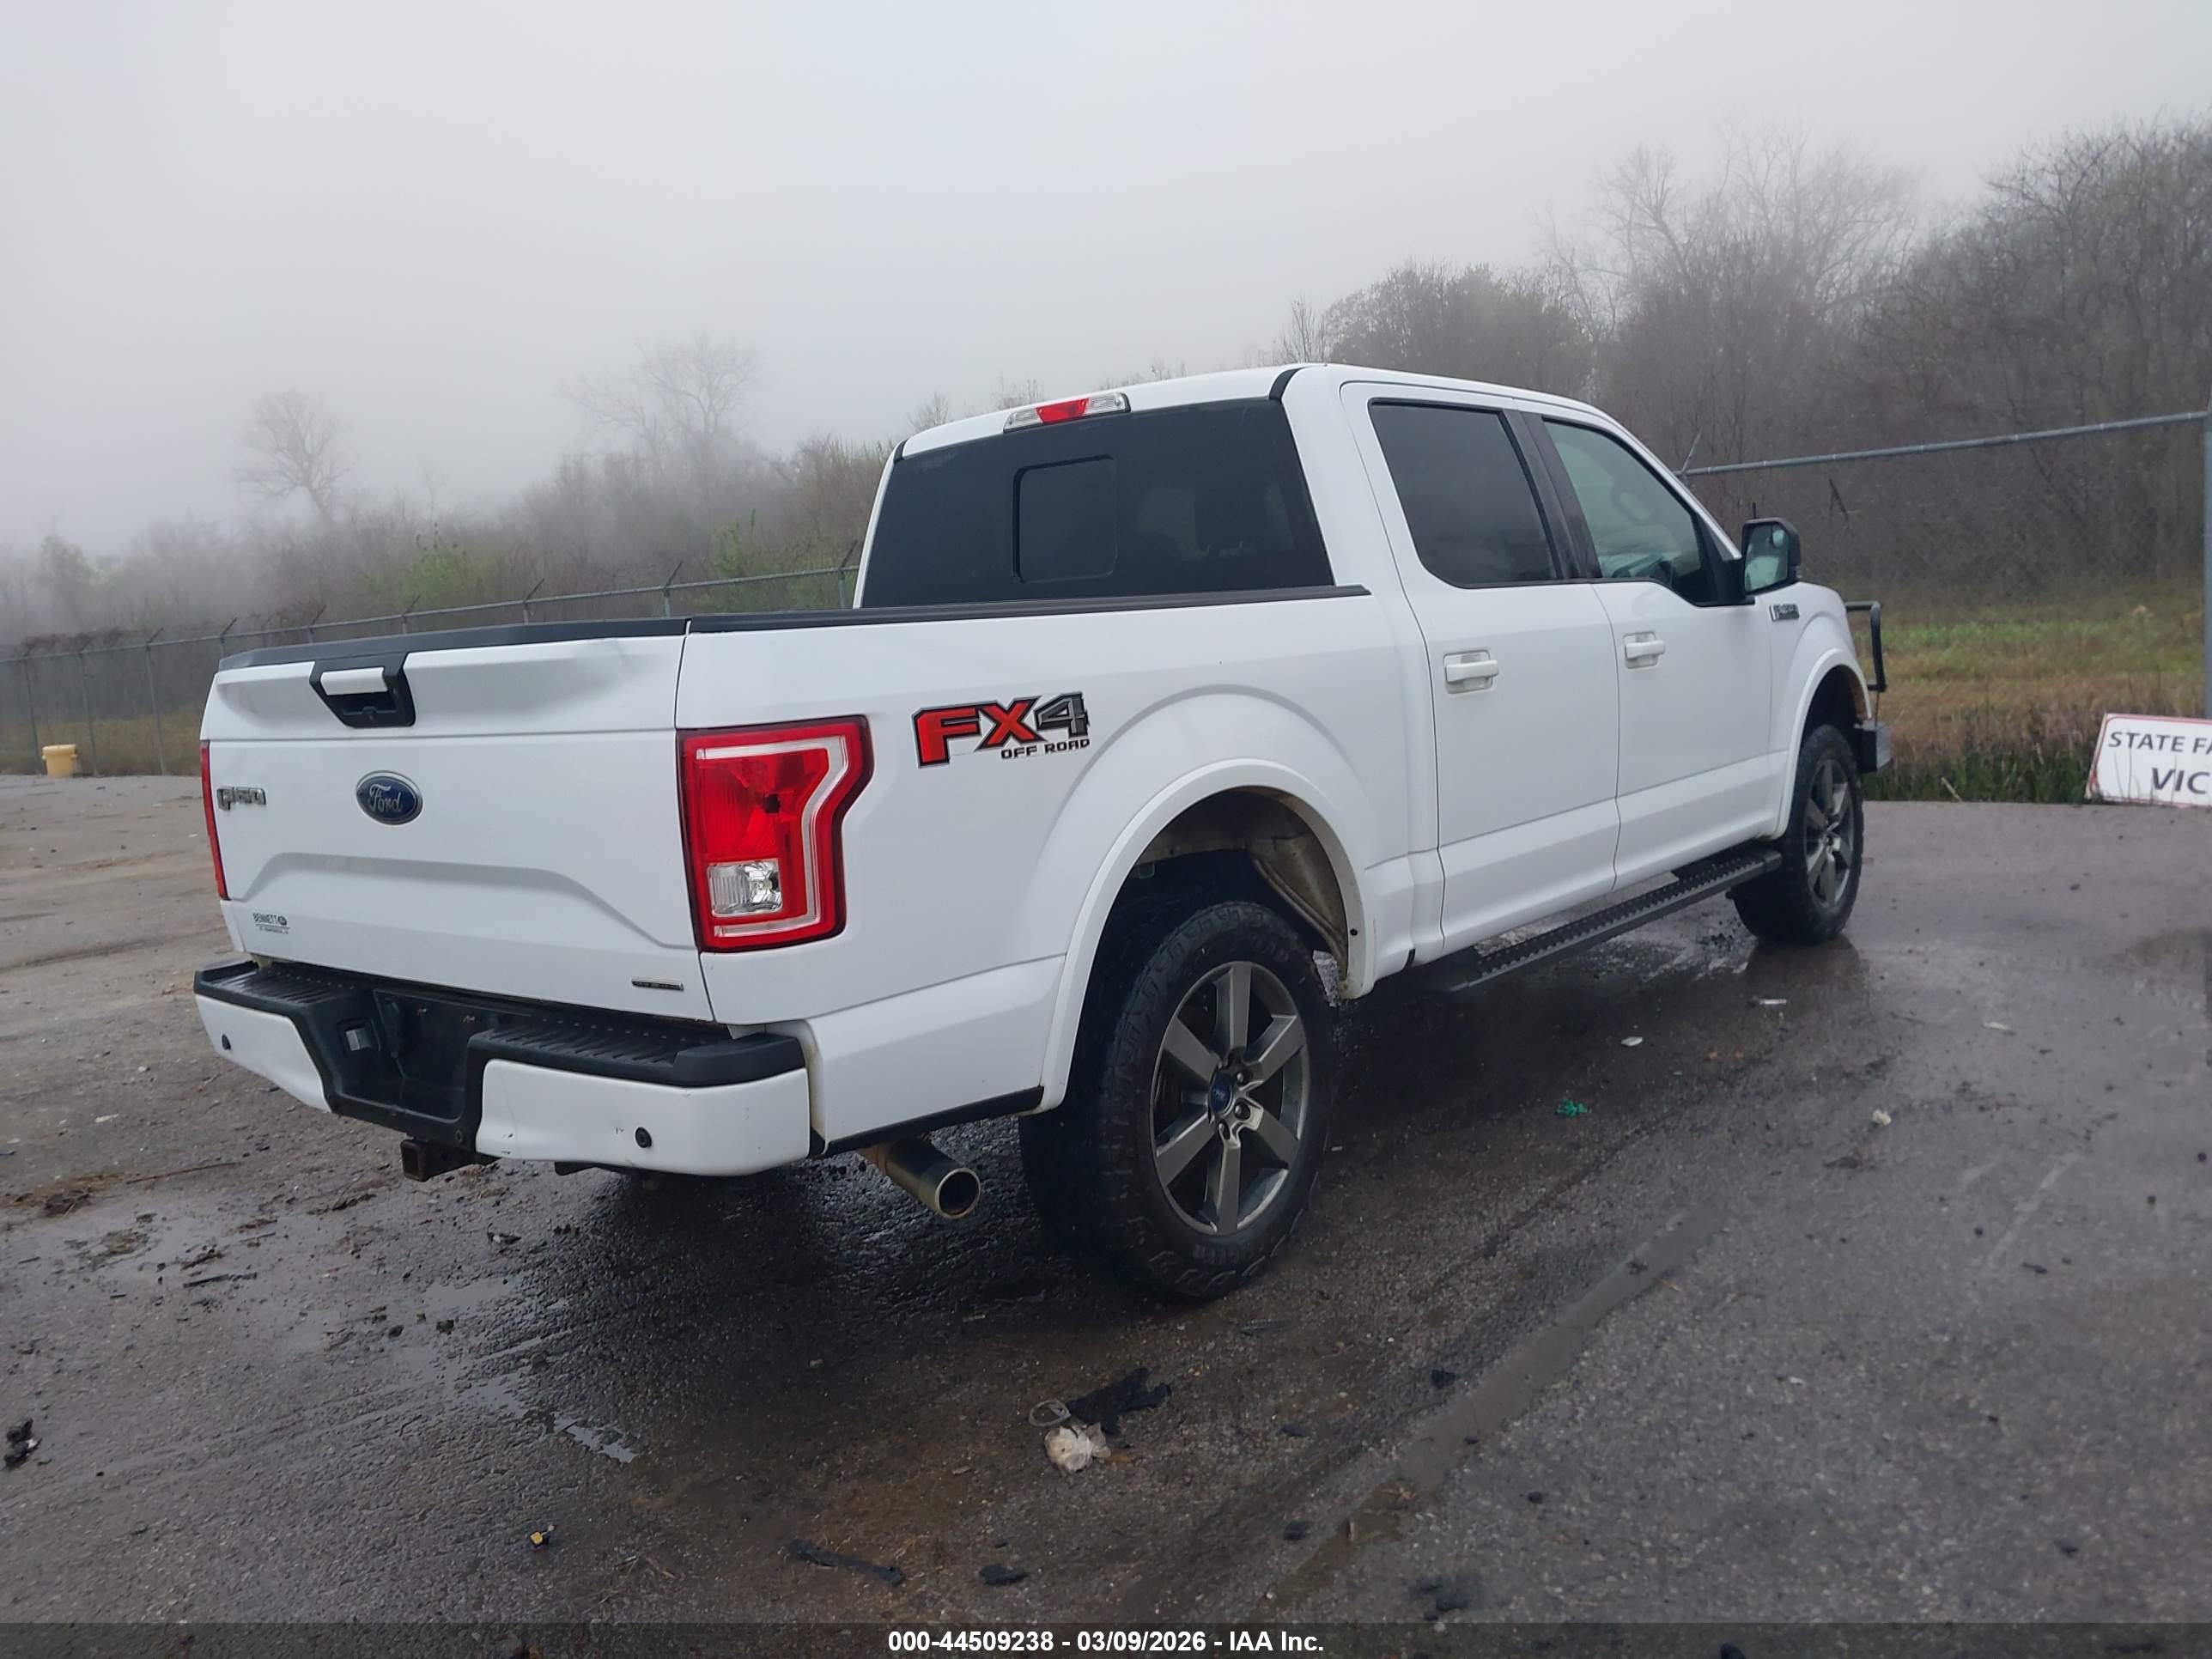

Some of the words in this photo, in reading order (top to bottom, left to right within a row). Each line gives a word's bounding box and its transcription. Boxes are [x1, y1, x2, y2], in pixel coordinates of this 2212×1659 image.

[912, 691, 1090, 768] FX4
[2108, 732, 2185, 752] STATE
[1000, 746, 1037, 759] OFF
[1044, 738, 1090, 754] ROAD
[2152, 767, 2209, 794] VIC
[368, 783, 402, 812] Ford
